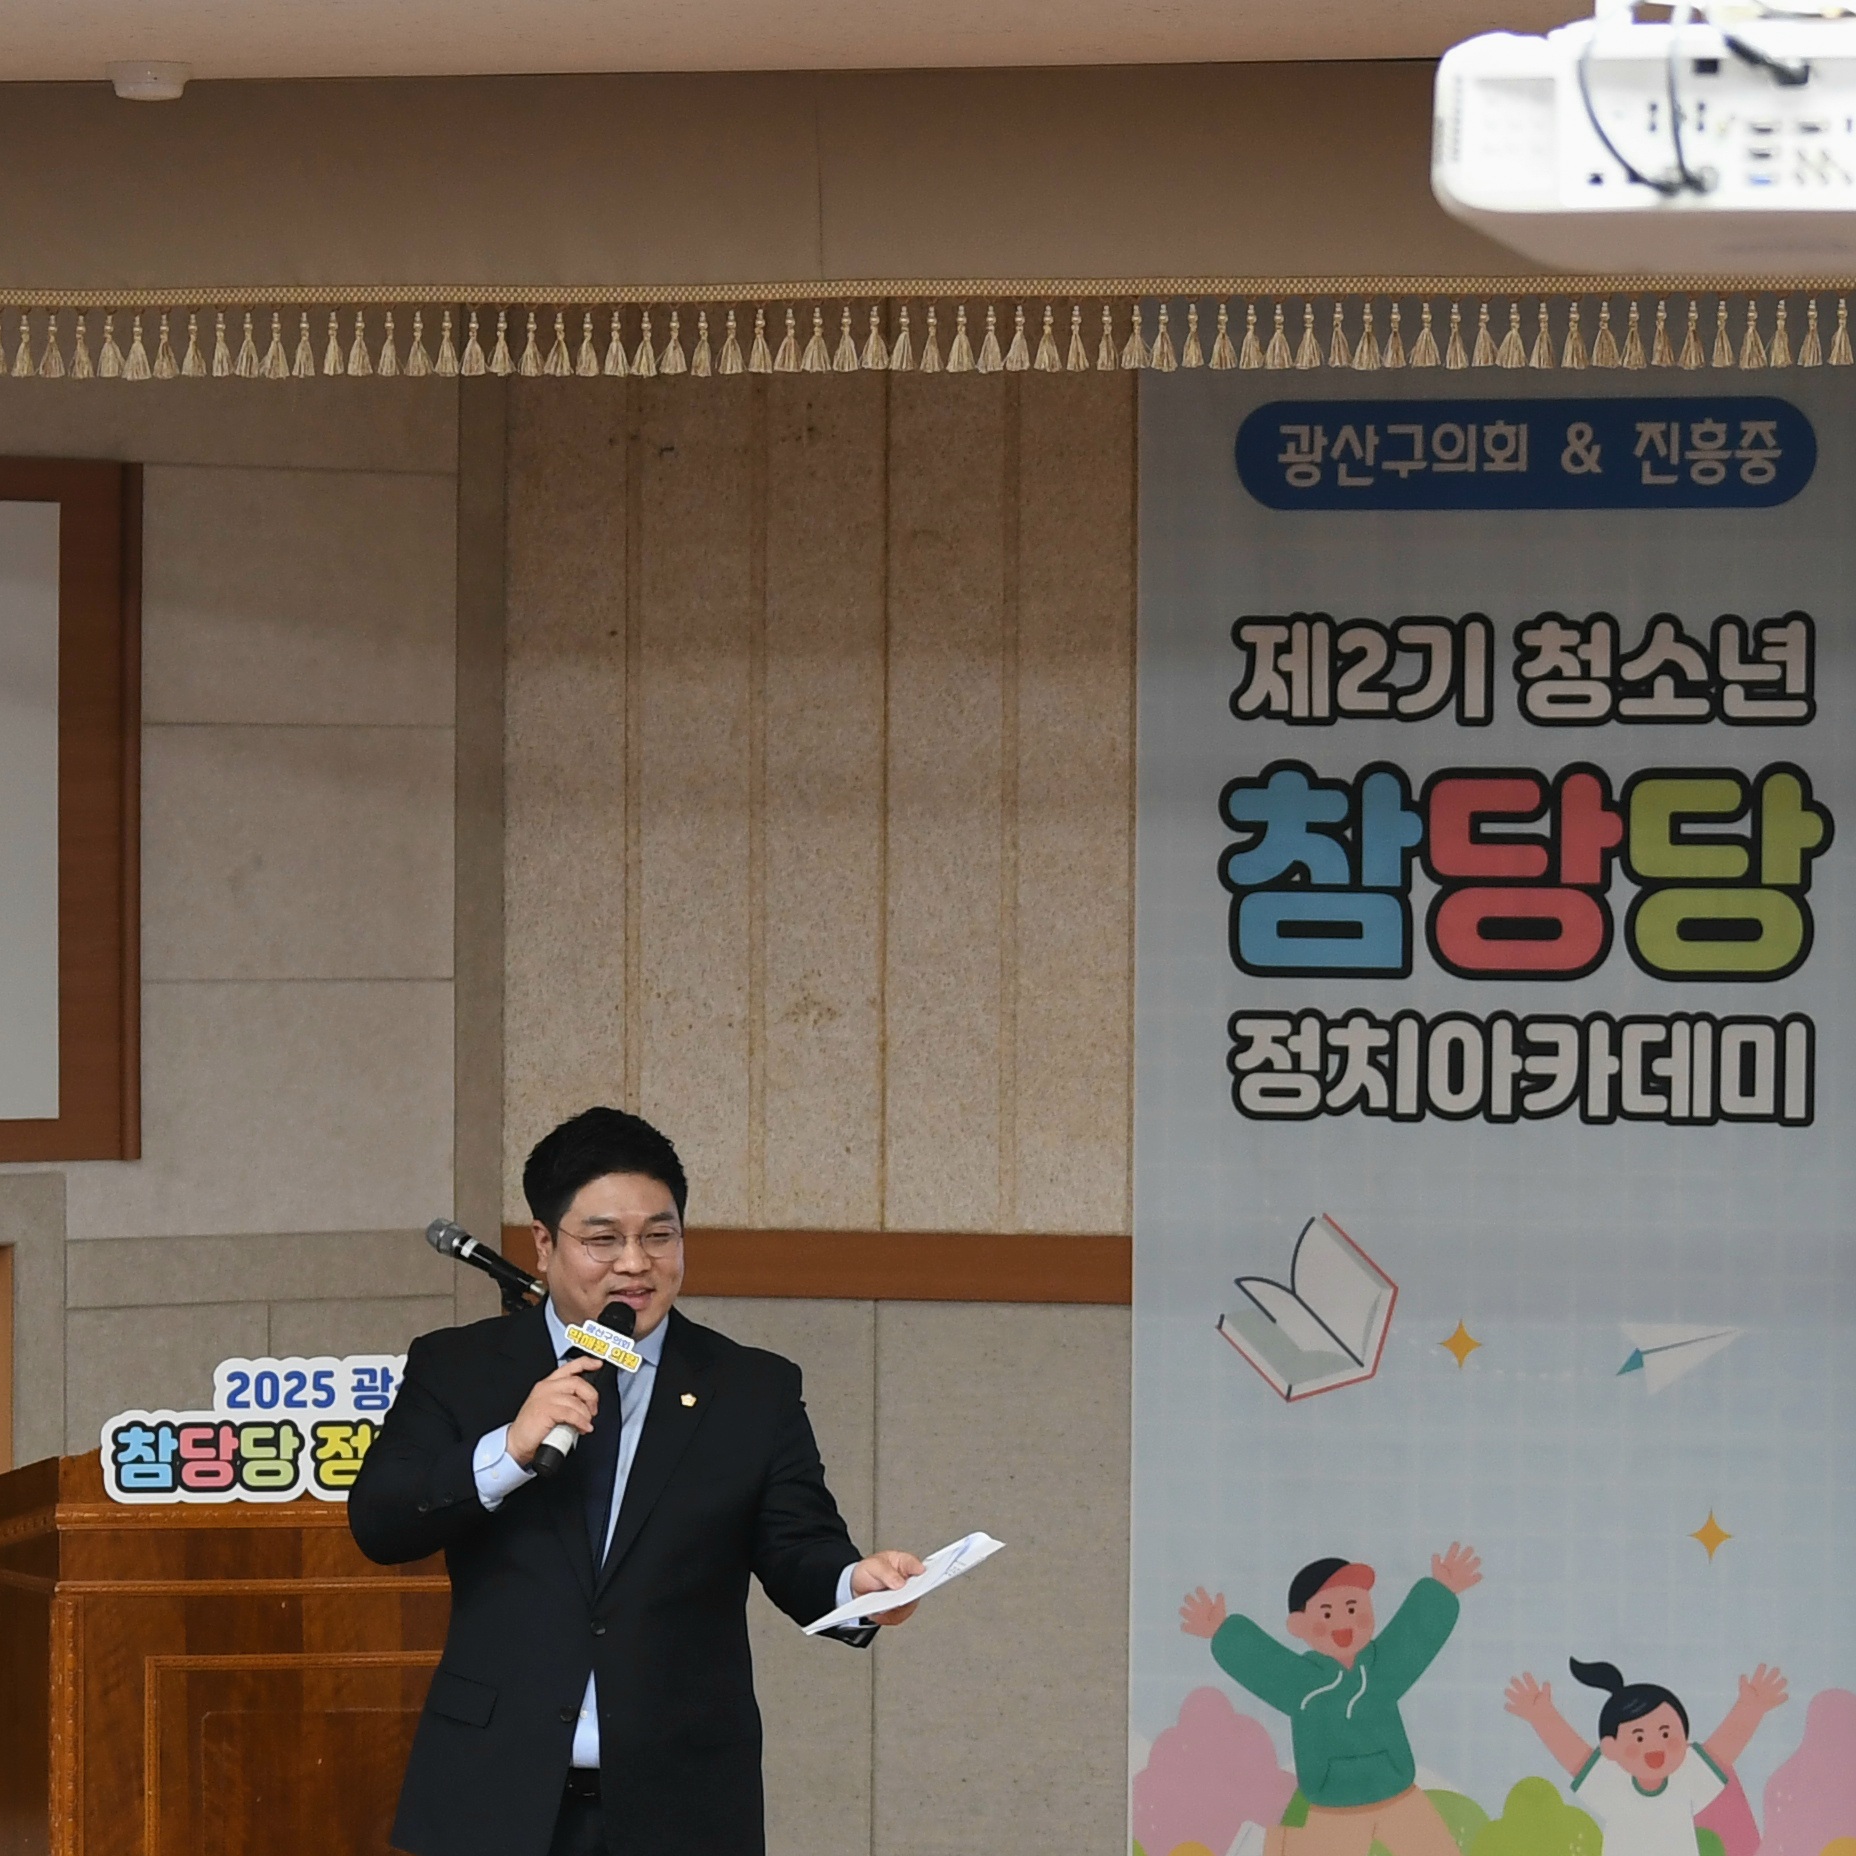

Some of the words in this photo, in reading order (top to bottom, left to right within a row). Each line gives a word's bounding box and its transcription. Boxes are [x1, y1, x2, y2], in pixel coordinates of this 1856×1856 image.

[1278, 419, 1528, 488] 광산구의회
[1561, 422, 1603, 475] &
[1633, 417, 1783, 486] 진흥중
[1230, 611, 1494, 726] 제2기
[1513, 611, 1816, 726] 청소년
[1218, 759, 1834, 982] 참당당
[1227, 1008, 1816, 1126] 정치아카데미
[226, 1370, 335, 1410] 2025
[351, 1367, 402, 1411] 광
[112, 1420, 305, 1493] 참당당
[311, 1418, 383, 1492] 정
